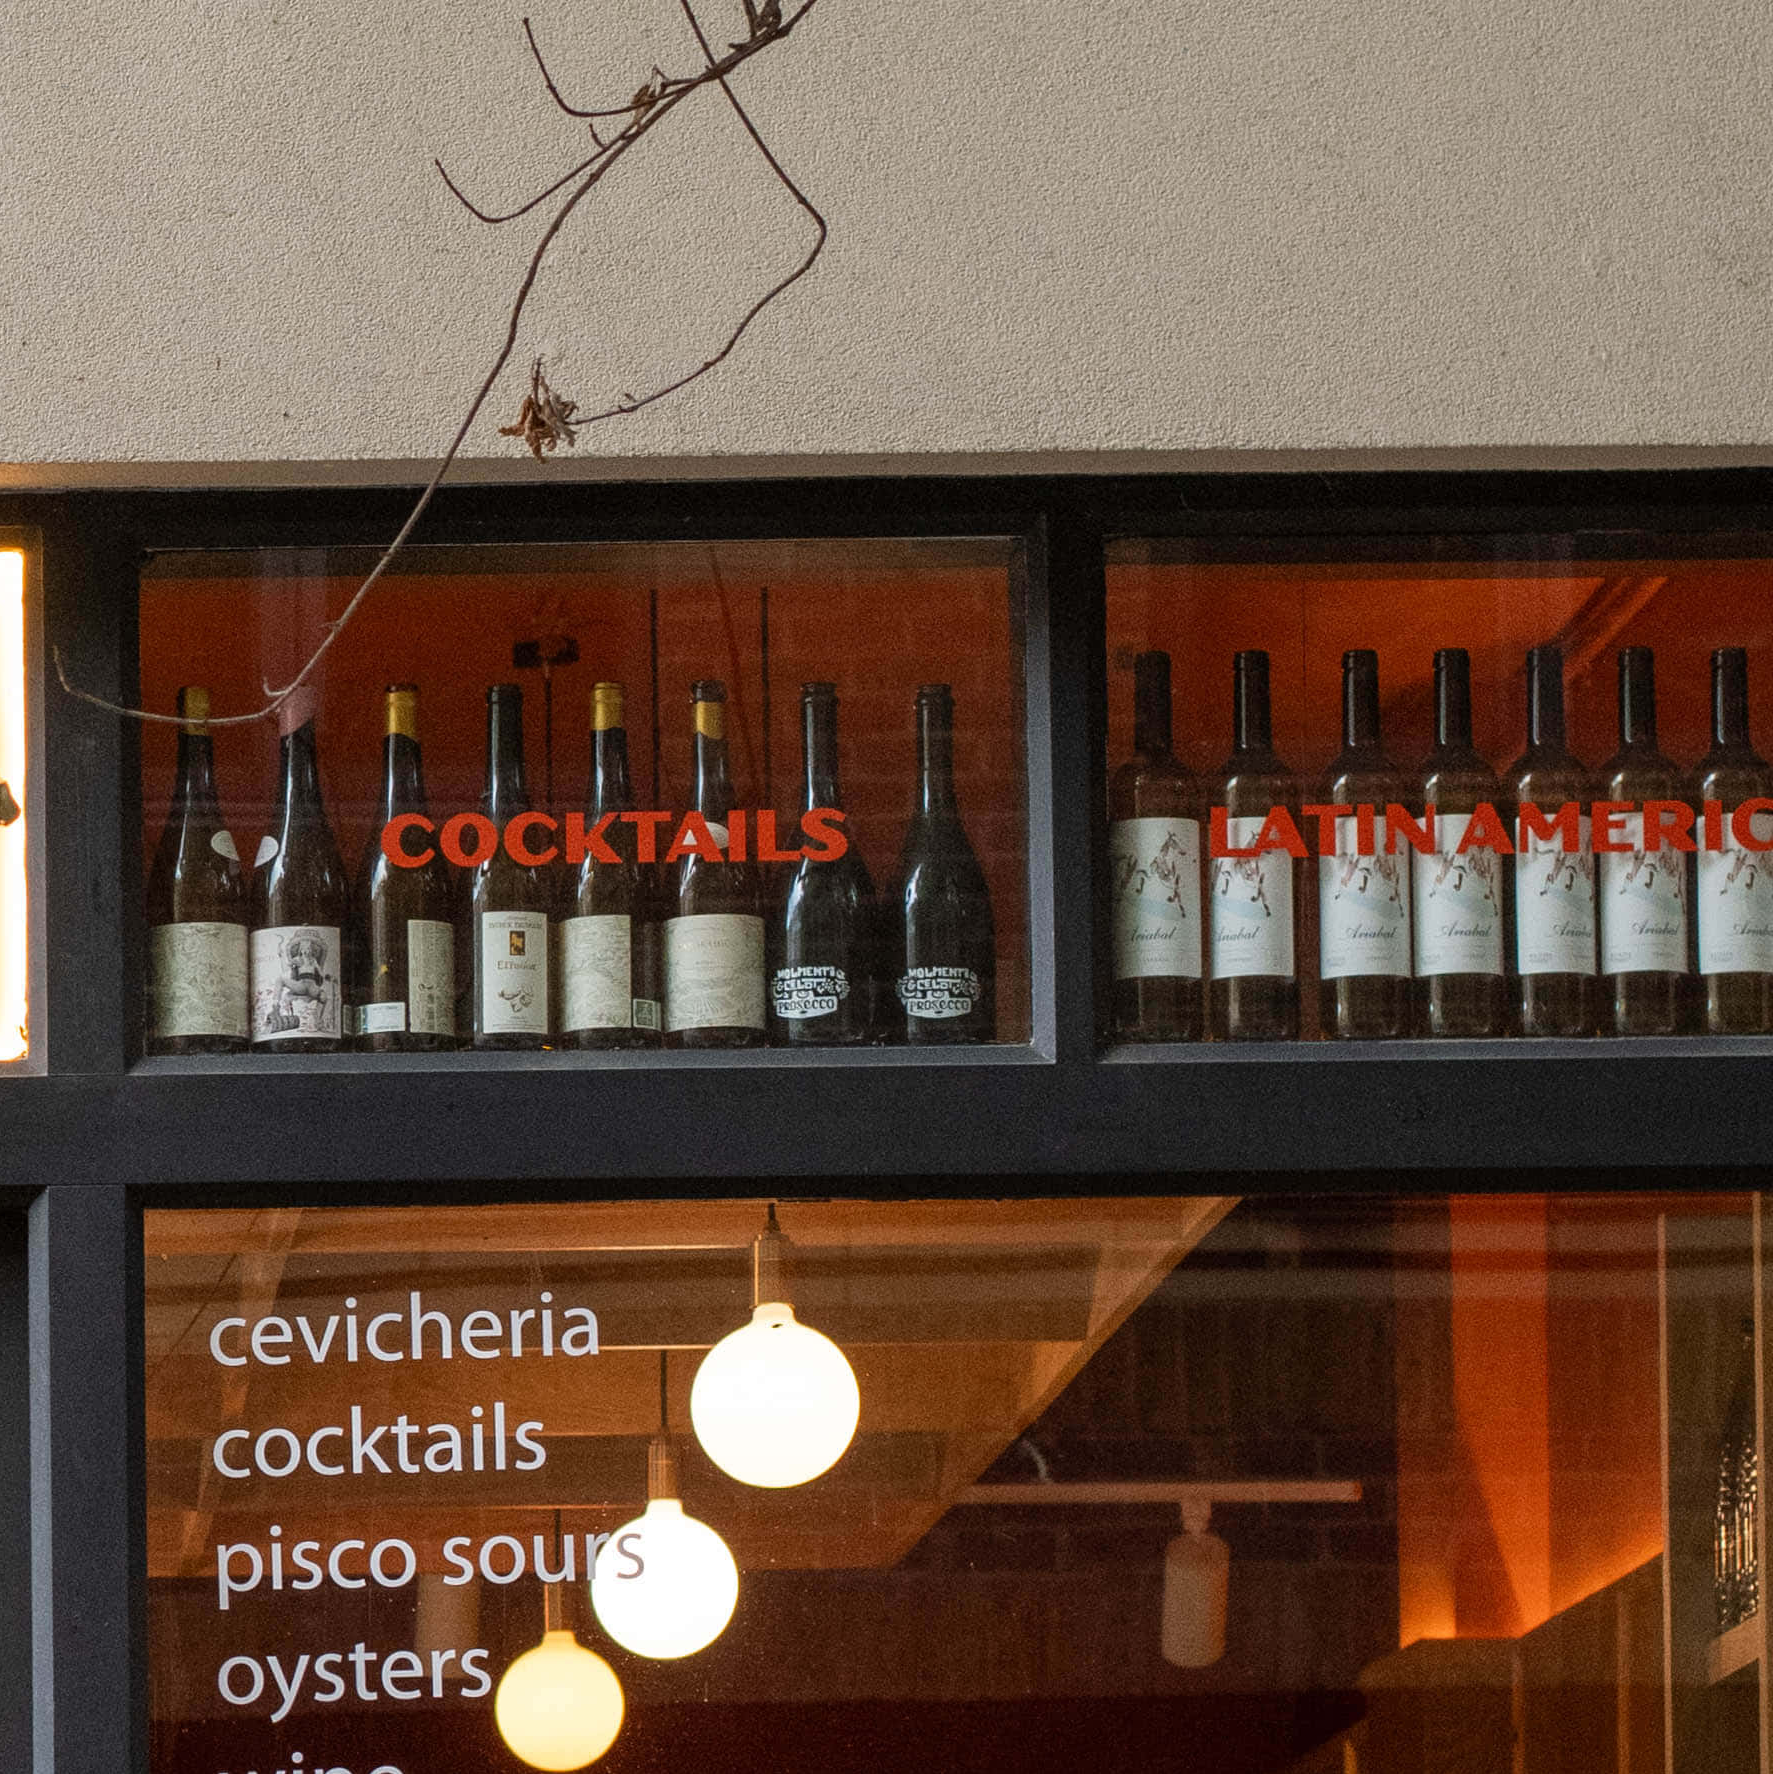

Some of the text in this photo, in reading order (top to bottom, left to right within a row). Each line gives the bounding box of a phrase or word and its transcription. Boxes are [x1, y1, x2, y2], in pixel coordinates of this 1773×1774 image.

[381, 808, 849, 868] COCKTAILS
[1210, 797, 1773, 858] LATIN AMERIC
[209, 1291, 600, 1367] cevicheria
[213, 1402, 547, 1478] cocktails
[217, 1525, 645, 1611] pisco sours
[218, 1643, 492, 1723] oysters
